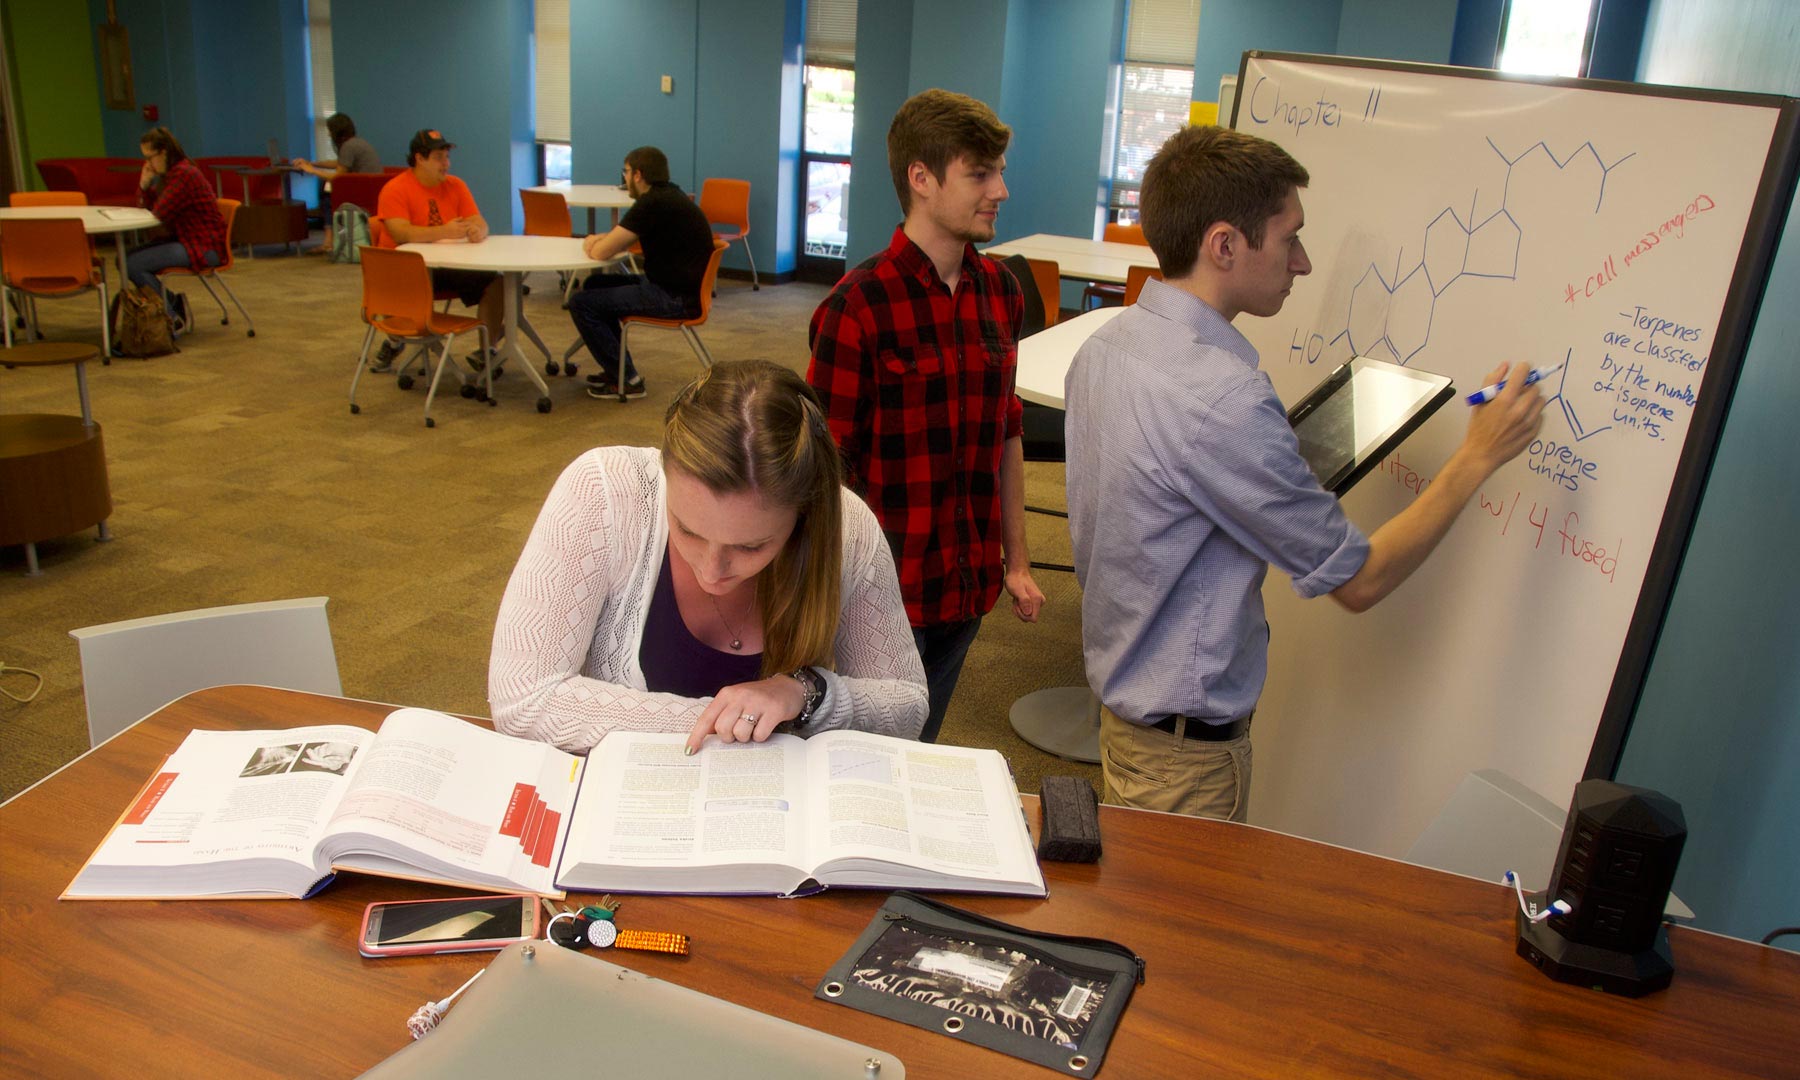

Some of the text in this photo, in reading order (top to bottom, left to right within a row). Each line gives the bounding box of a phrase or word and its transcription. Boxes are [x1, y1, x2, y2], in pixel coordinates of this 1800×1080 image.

[1288, 328, 1324, 365] HO
[1603, 331, 1631, 348] are
[1600, 353, 1698, 408] by the number
[1593, 381, 1674, 422] of isoprene
[1528, 439, 1598, 481] oprene
[1528, 458, 1579, 491] units
[1480, 492, 1521, 536] w/
[1529, 502, 1549, 549] 4
[1558, 511, 1623, 583] fused
